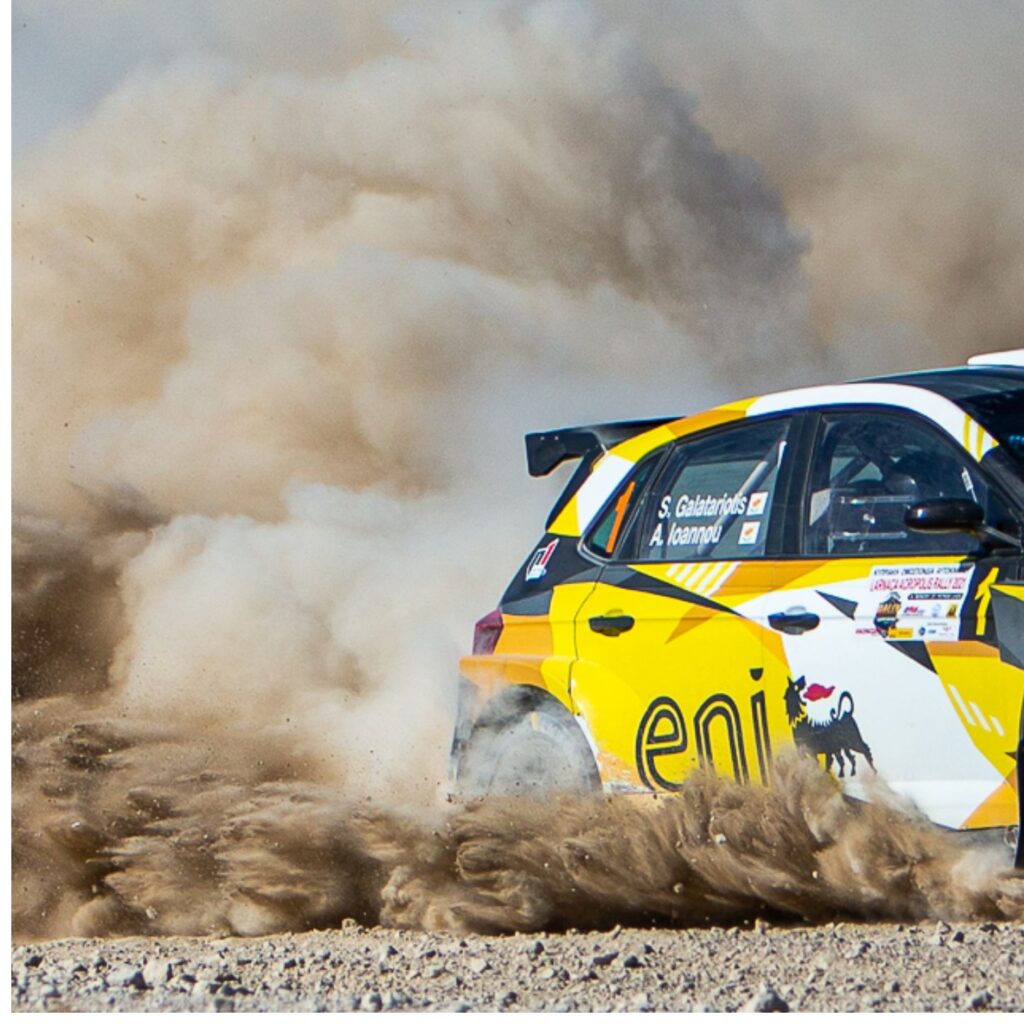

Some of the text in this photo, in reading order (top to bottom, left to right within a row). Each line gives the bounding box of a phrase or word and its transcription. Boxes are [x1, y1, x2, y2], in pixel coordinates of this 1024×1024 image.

[658, 495, 671, 518] S.
[650, 523, 723, 546] A. Ioannou
[974, 567, 999, 636] 1
[636, 668, 774, 792] eni
